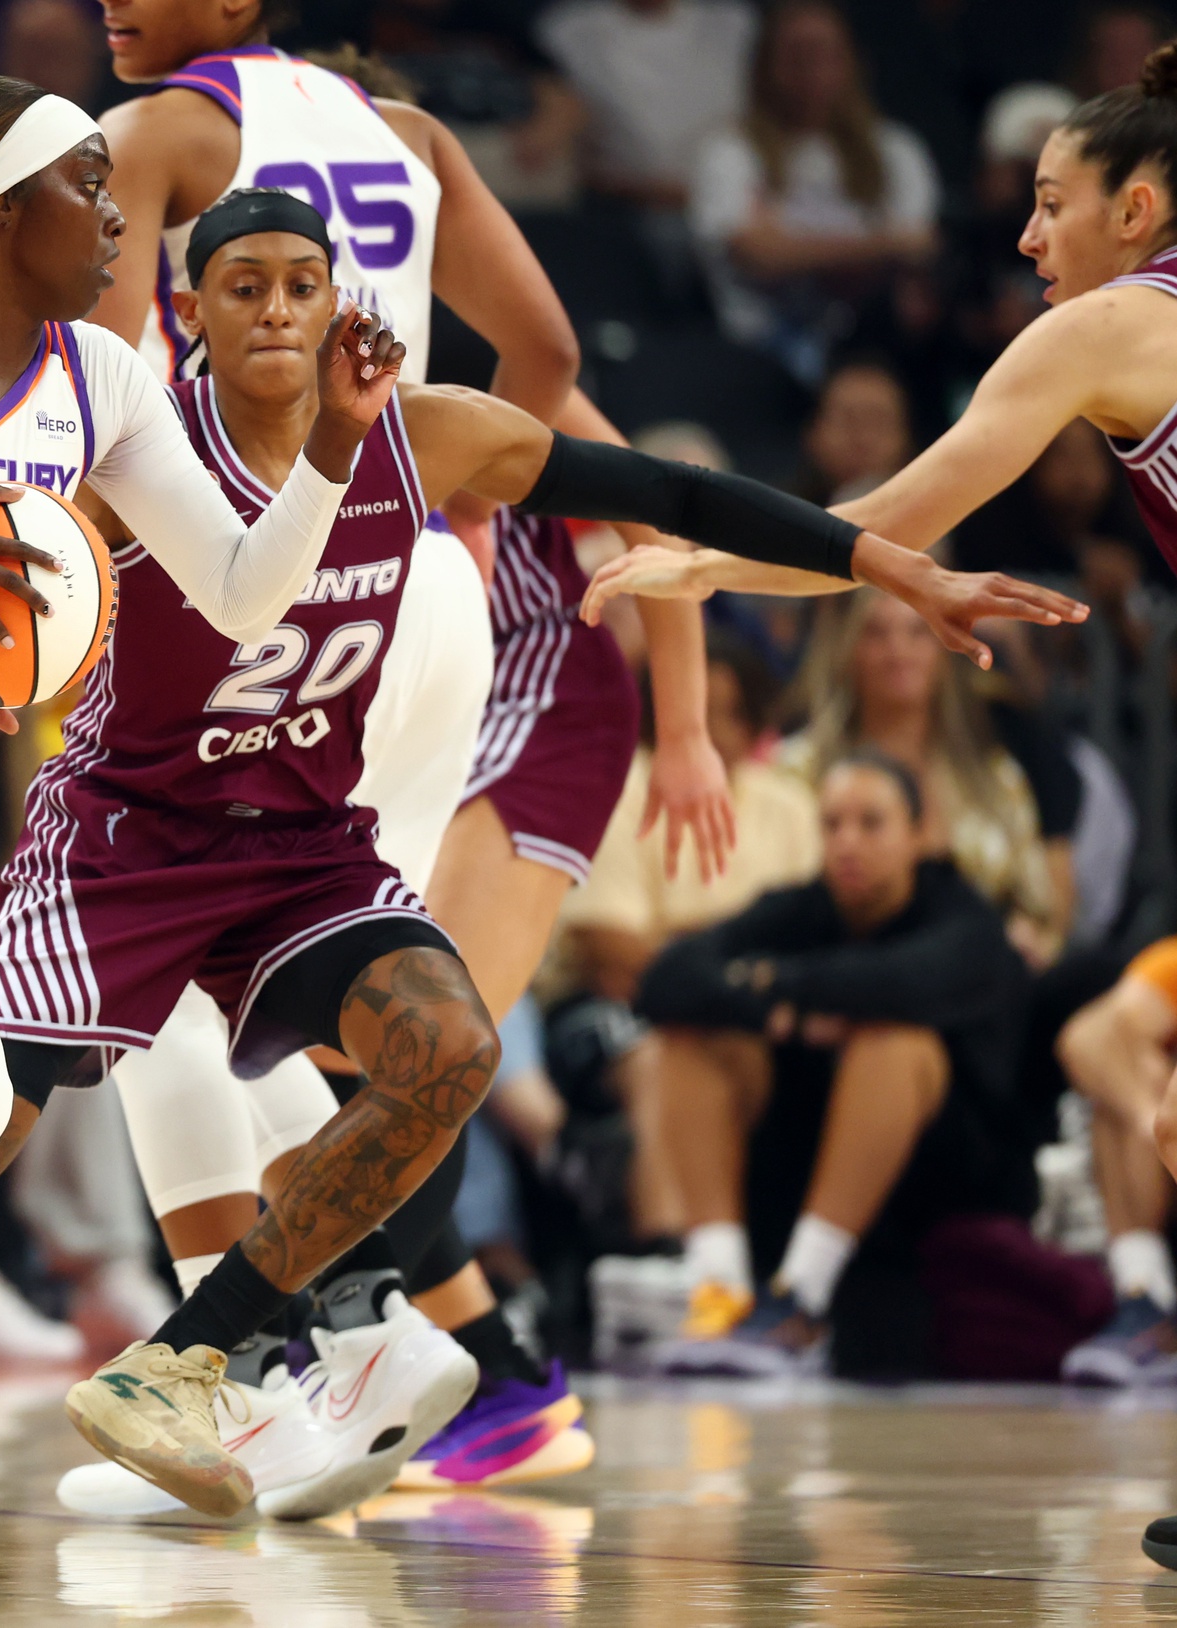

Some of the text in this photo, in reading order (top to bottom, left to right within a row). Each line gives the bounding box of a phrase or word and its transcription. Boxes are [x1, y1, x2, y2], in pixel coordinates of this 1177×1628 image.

[36, 415, 76, 433] HERO
[339, 499, 400, 519] SEPHORA
[203, 619, 384, 715] 20
